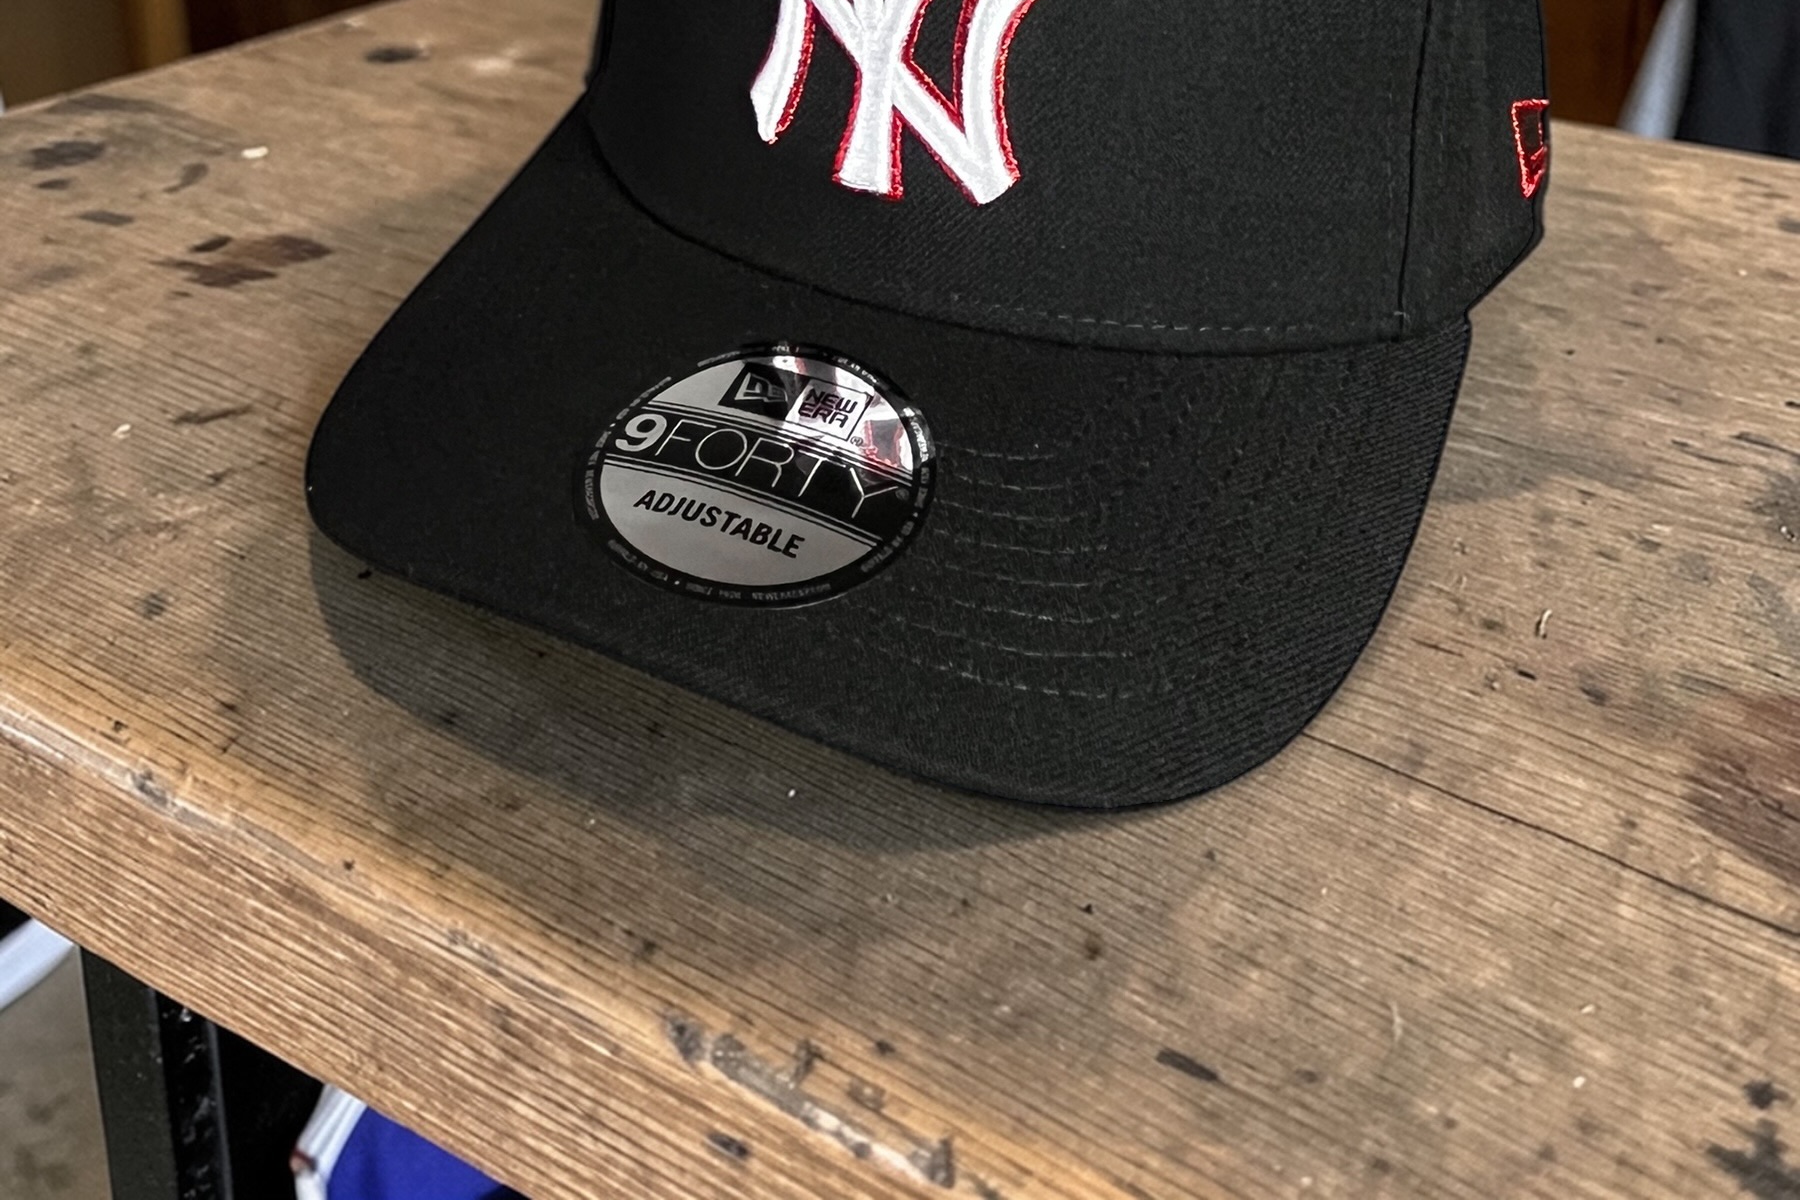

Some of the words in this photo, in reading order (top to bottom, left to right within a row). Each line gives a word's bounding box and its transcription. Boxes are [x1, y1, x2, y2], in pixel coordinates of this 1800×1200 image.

[798, 403, 848, 428] ERA
[806, 389, 857, 413] NEW
[615, 413, 899, 518] 9FORTY
[633, 490, 805, 558] ADJUSTABLE
